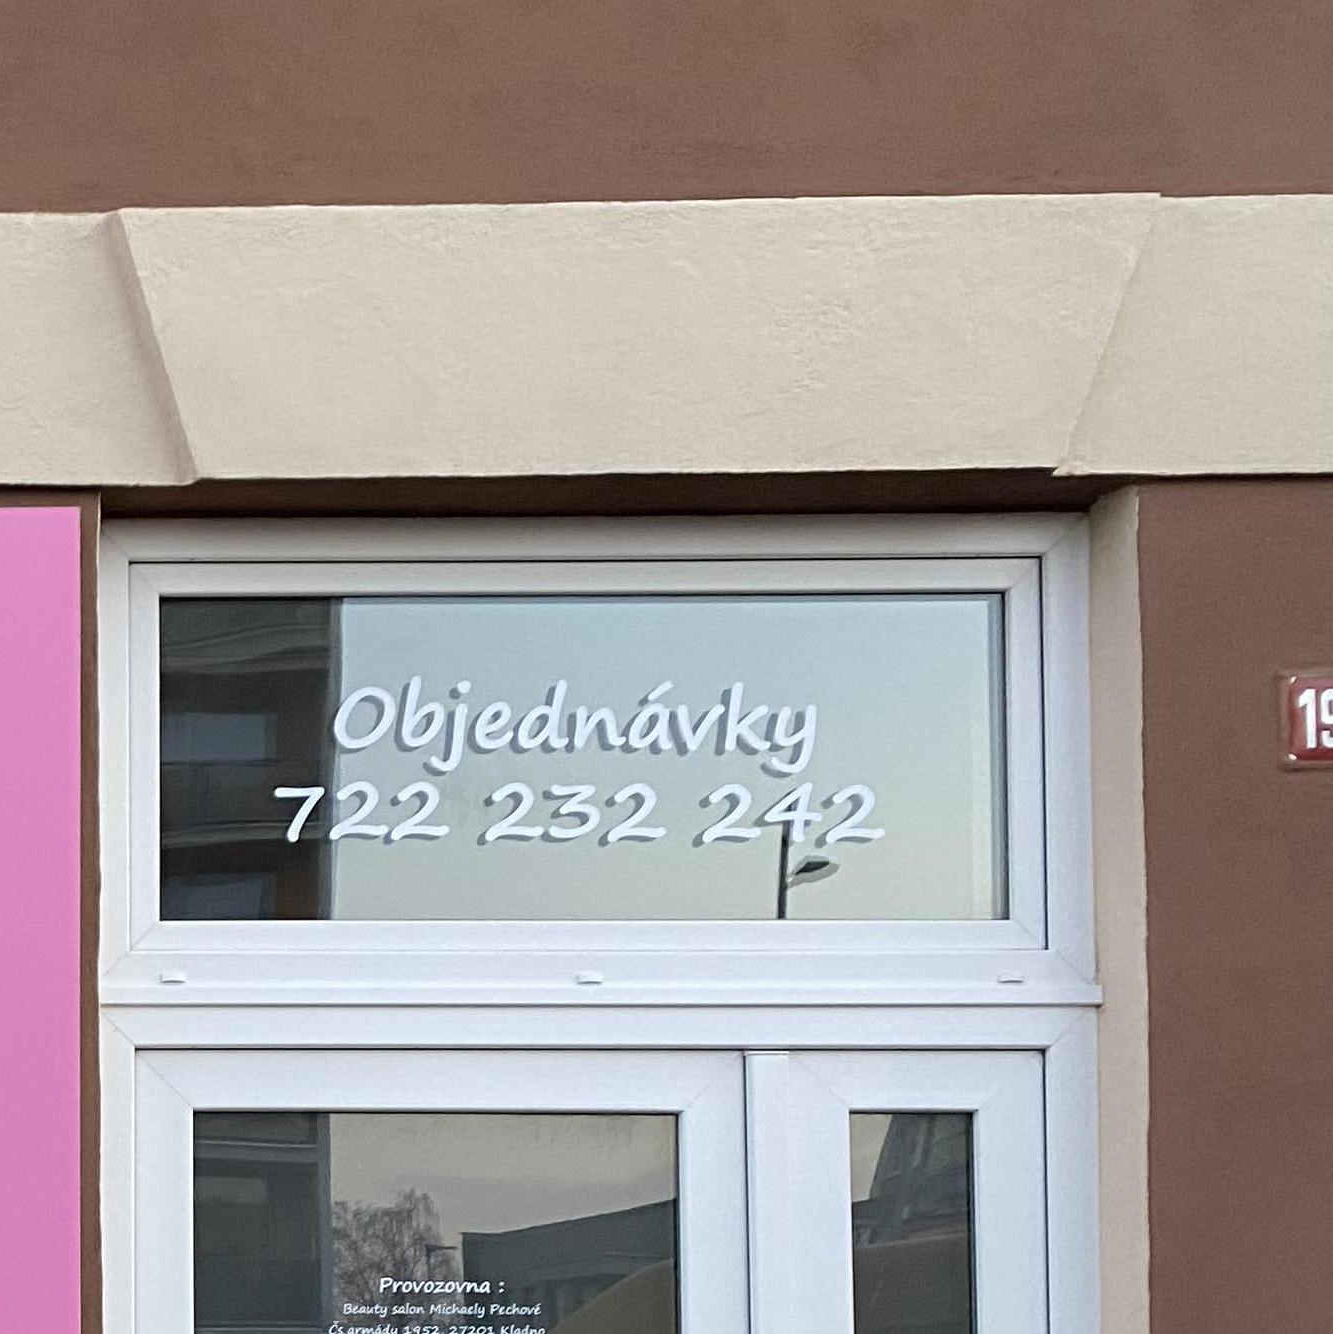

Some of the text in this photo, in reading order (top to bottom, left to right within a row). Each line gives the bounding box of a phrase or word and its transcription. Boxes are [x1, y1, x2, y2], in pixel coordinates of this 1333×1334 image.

[334, 675, 817, 774] Objednávky
[273, 782, 886, 844] 722 232 242
[379, 1277, 491, 1294] Provozovna
[342, 1302, 542, 1319] Beauty salon Michaely Pechové
